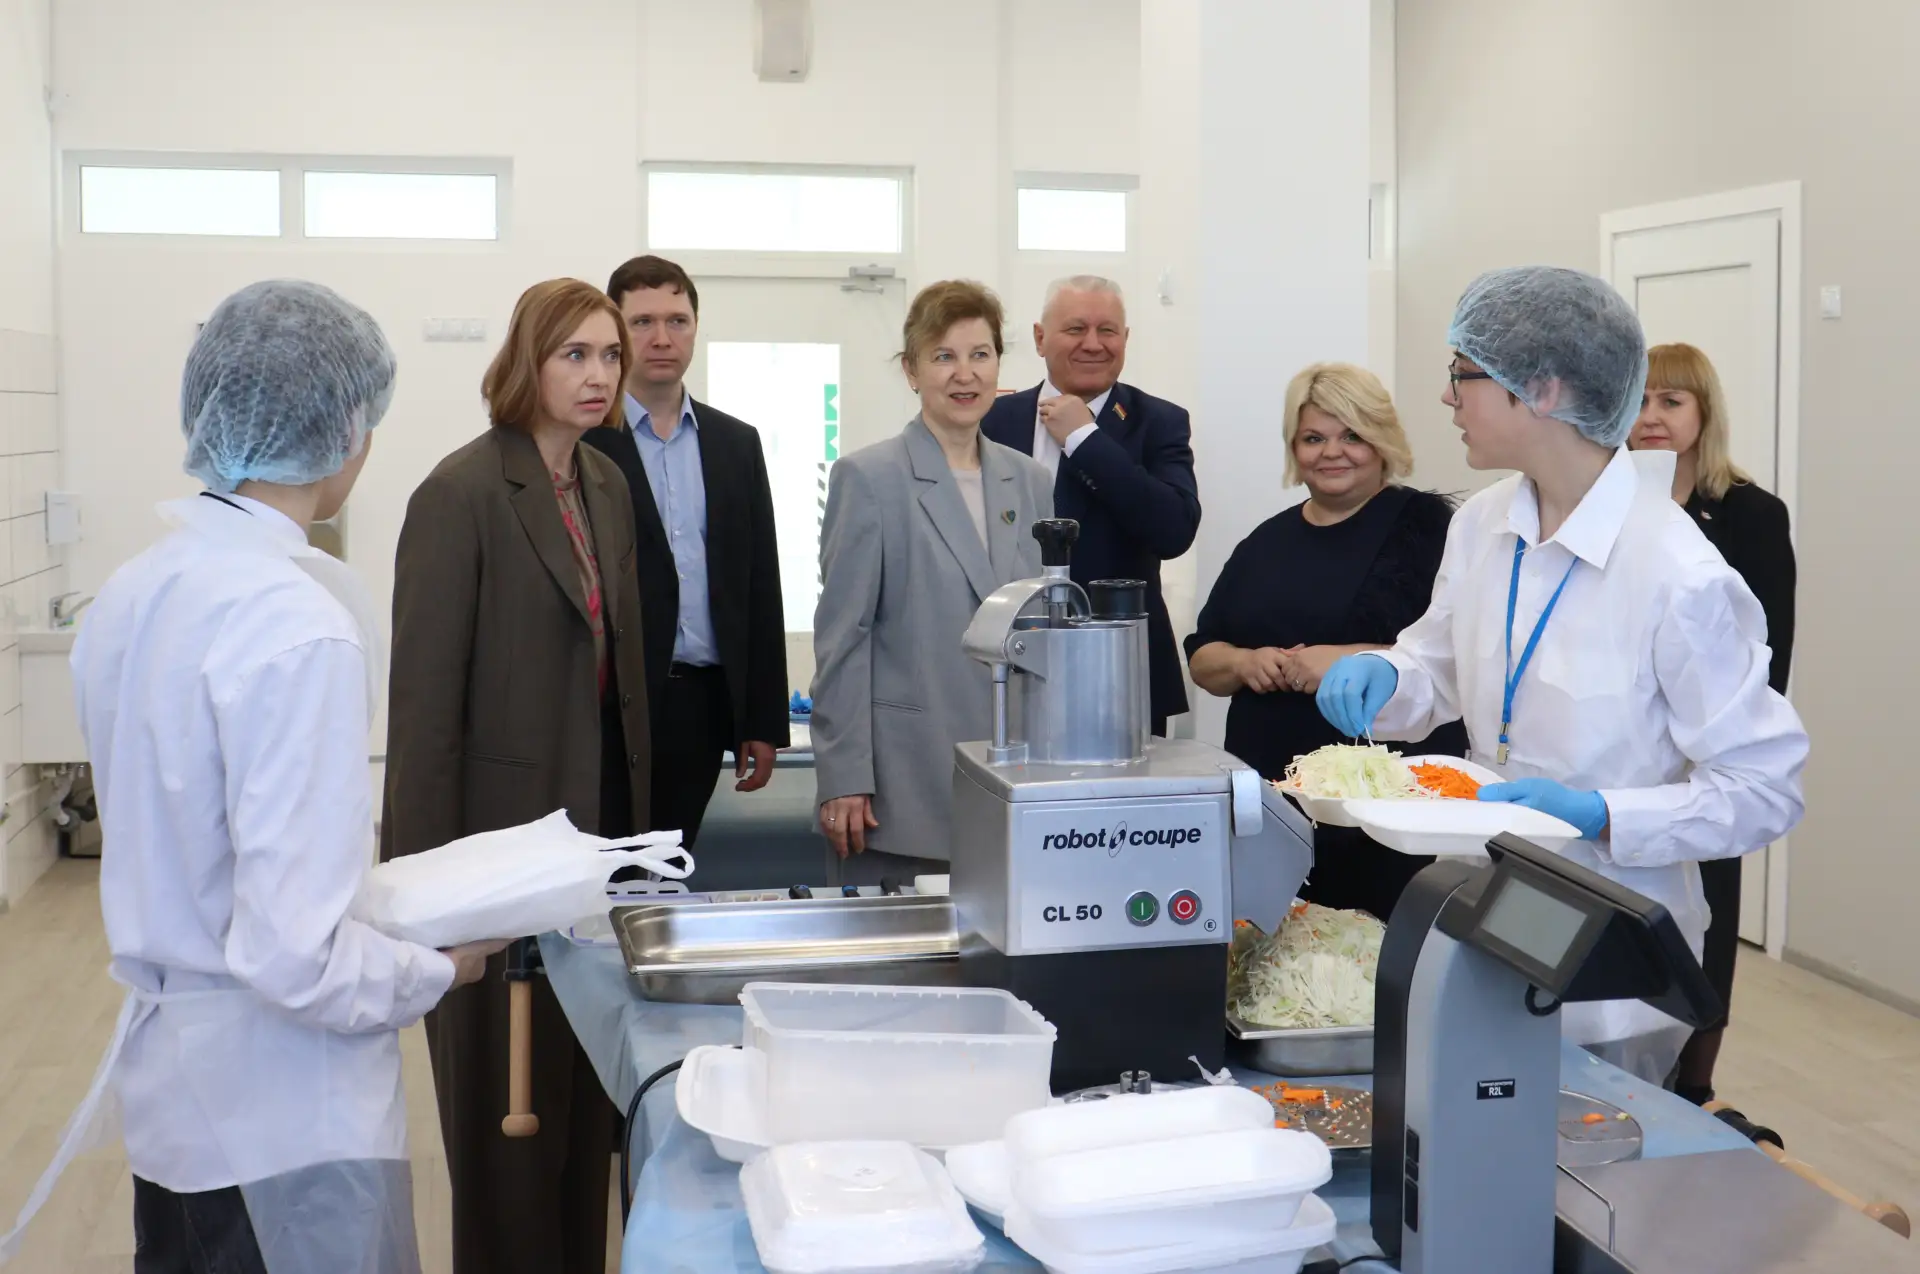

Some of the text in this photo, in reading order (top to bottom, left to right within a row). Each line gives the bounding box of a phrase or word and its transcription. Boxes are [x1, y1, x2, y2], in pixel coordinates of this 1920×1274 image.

[1042, 827, 1202, 850] robot coupe
[1043, 904, 1103, 923] CL 50
[1488, 1086, 1504, 1097] R2L
